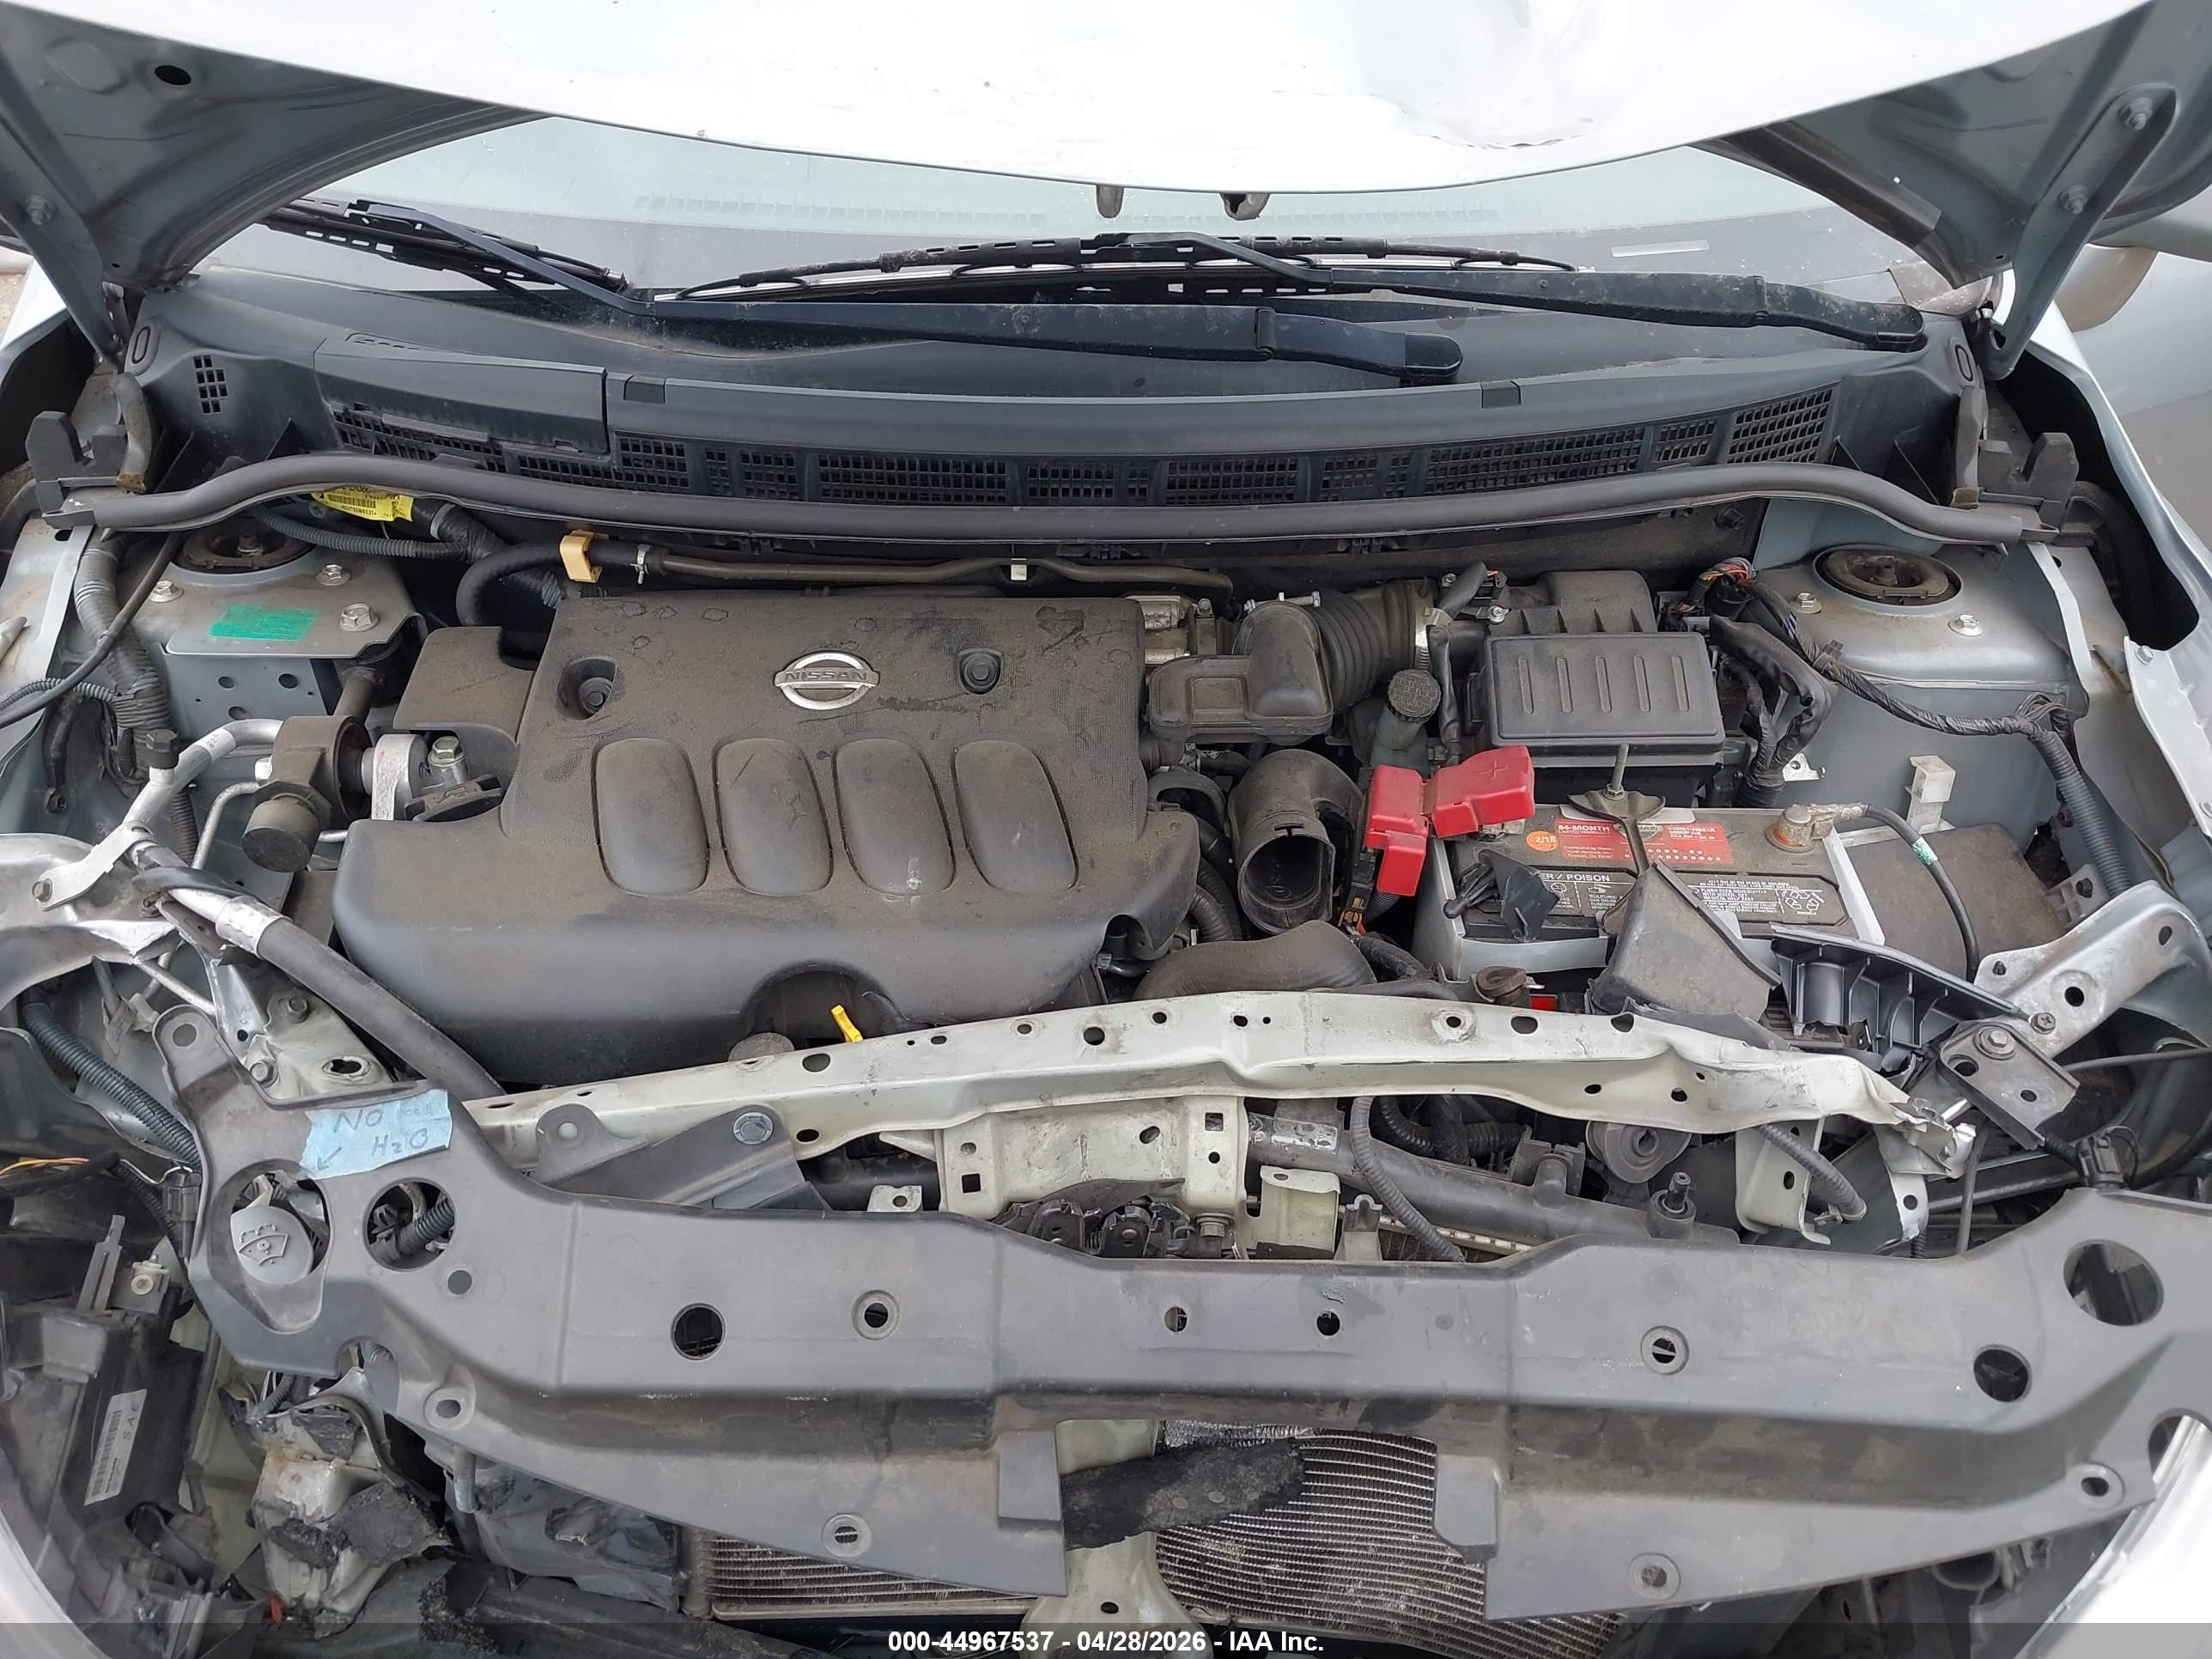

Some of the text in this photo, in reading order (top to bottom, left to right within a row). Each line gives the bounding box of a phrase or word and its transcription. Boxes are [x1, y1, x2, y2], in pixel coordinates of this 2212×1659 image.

[784, 670, 867, 682] NISSAN
[1566, 873, 1610, 882] POISON
[333, 1109, 385, 1133] NO
